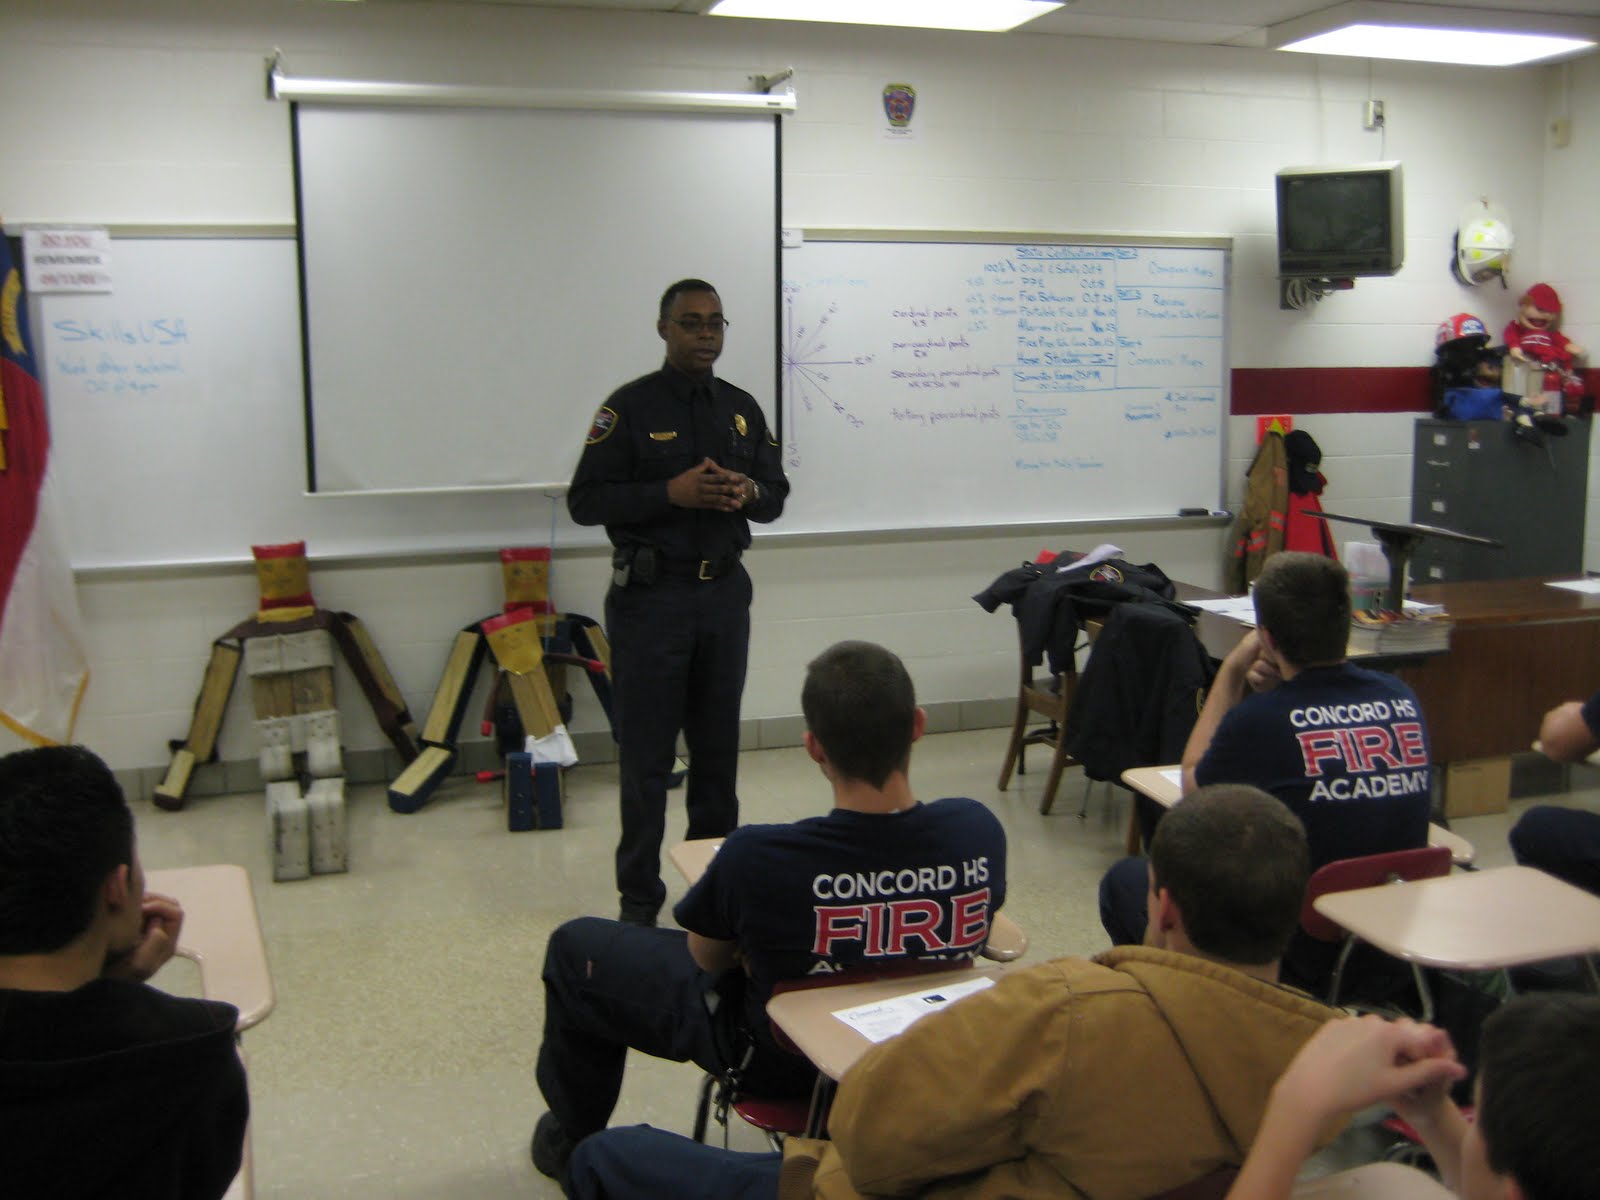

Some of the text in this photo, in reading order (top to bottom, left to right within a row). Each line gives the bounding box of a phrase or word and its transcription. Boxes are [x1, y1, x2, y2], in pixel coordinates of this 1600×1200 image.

[1289, 699, 1417, 727] CONCORD HS
[1295, 722, 1428, 777] FIRE
[1308, 770, 1429, 801] ACADEMY
[812, 856, 990, 899] CONCORD HS
[811, 887, 991, 957] FIRE
